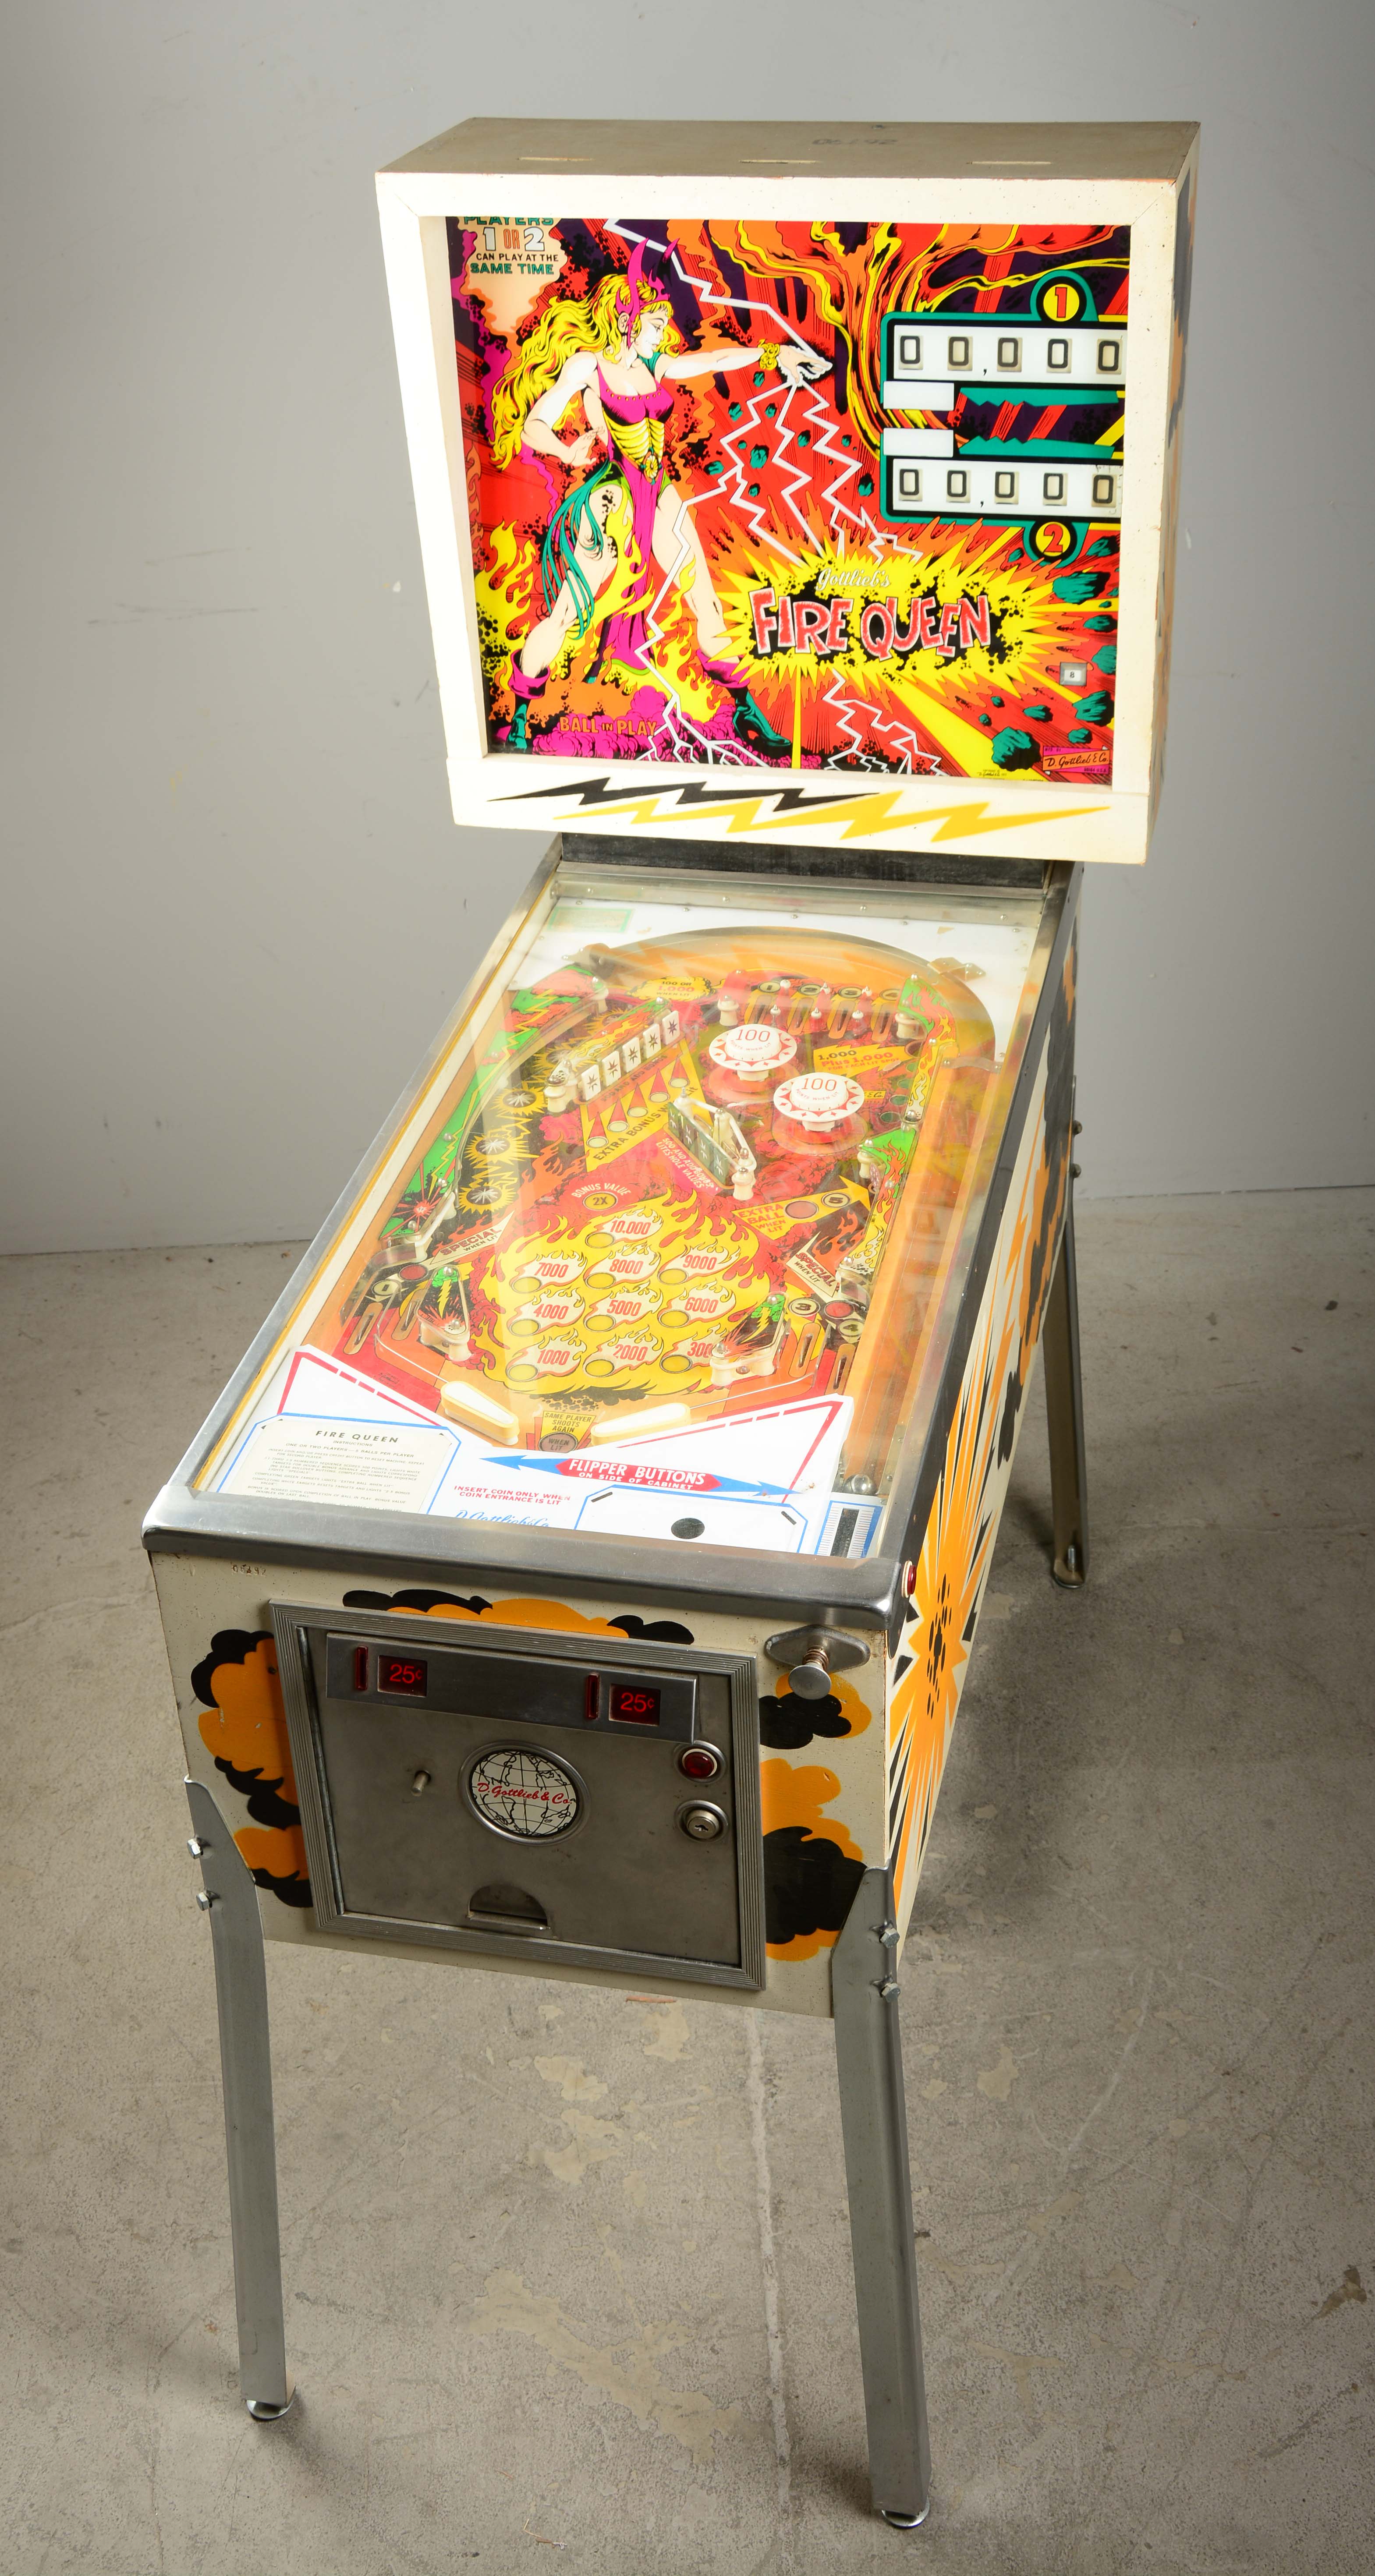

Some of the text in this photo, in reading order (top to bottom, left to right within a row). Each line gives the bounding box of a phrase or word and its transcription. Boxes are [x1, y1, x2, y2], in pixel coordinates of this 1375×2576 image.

[464, 216, 554, 226] PLAYERS
[483, 226, 545, 251] 1 OR 2
[470, 263, 554, 275] SAME TIME
[1055, 287, 1068, 318] 1
[1043, 524, 1063, 552] 2
[815, 568, 891, 591] Gottlieb's
[748, 587, 991, 662] FIRE QUEEN
[560, 716, 656, 736] BALL IN PLAY
[1045, 757, 1056, 767] D.
[1059, 754, 1091, 768] Gottlieb
[1099, 752, 1109, 762] Co.
[736, 1029, 770, 1042] 100
[818, 1050, 857, 1060] 1,000
[853, 1052, 893, 1063] 1,000
[801, 1078, 837, 1091] 100
[593, 1111, 662, 1160] EXTRA BONUS
[674, 1149, 686, 1159] AND
[656, 1142, 705, 1188] LITES HOLE VALUES
[571, 1182, 631, 1198] BONUS VALUE
[593, 1196, 608, 1205] 2X
[738, 1204, 784, 1218] EXTRA
[747, 1212, 784, 1224] BALL
[756, 1219, 786, 1229] WHEN
[440, 1228, 502, 1255] SPECIAL
[463, 1240, 486, 1251] WHEN
[534, 1256, 717, 1277] 7000 8000 9000
[794, 1261, 821, 1283] WHEN LIT
[795, 1252, 836, 1287] SPECIAL
[533, 1296, 718, 1320] 4000 5000 6000
[795, 1302, 812, 1311] 3
[537, 1342, 712, 1365] 1000 2000 300
[352, 1434, 399, 1443] QUEEN
[569, 1459, 705, 1485] FLIPPER BUTTONS
[648, 1480, 693, 1490] CABINET
[485, 1494, 533, 1503] ENTRANCE
[390, 1664, 422, 1684] 25¢
[620, 1692, 654, 1713] 25¢
[477, 1782, 572, 1804] D. Gottlieb & Co.
